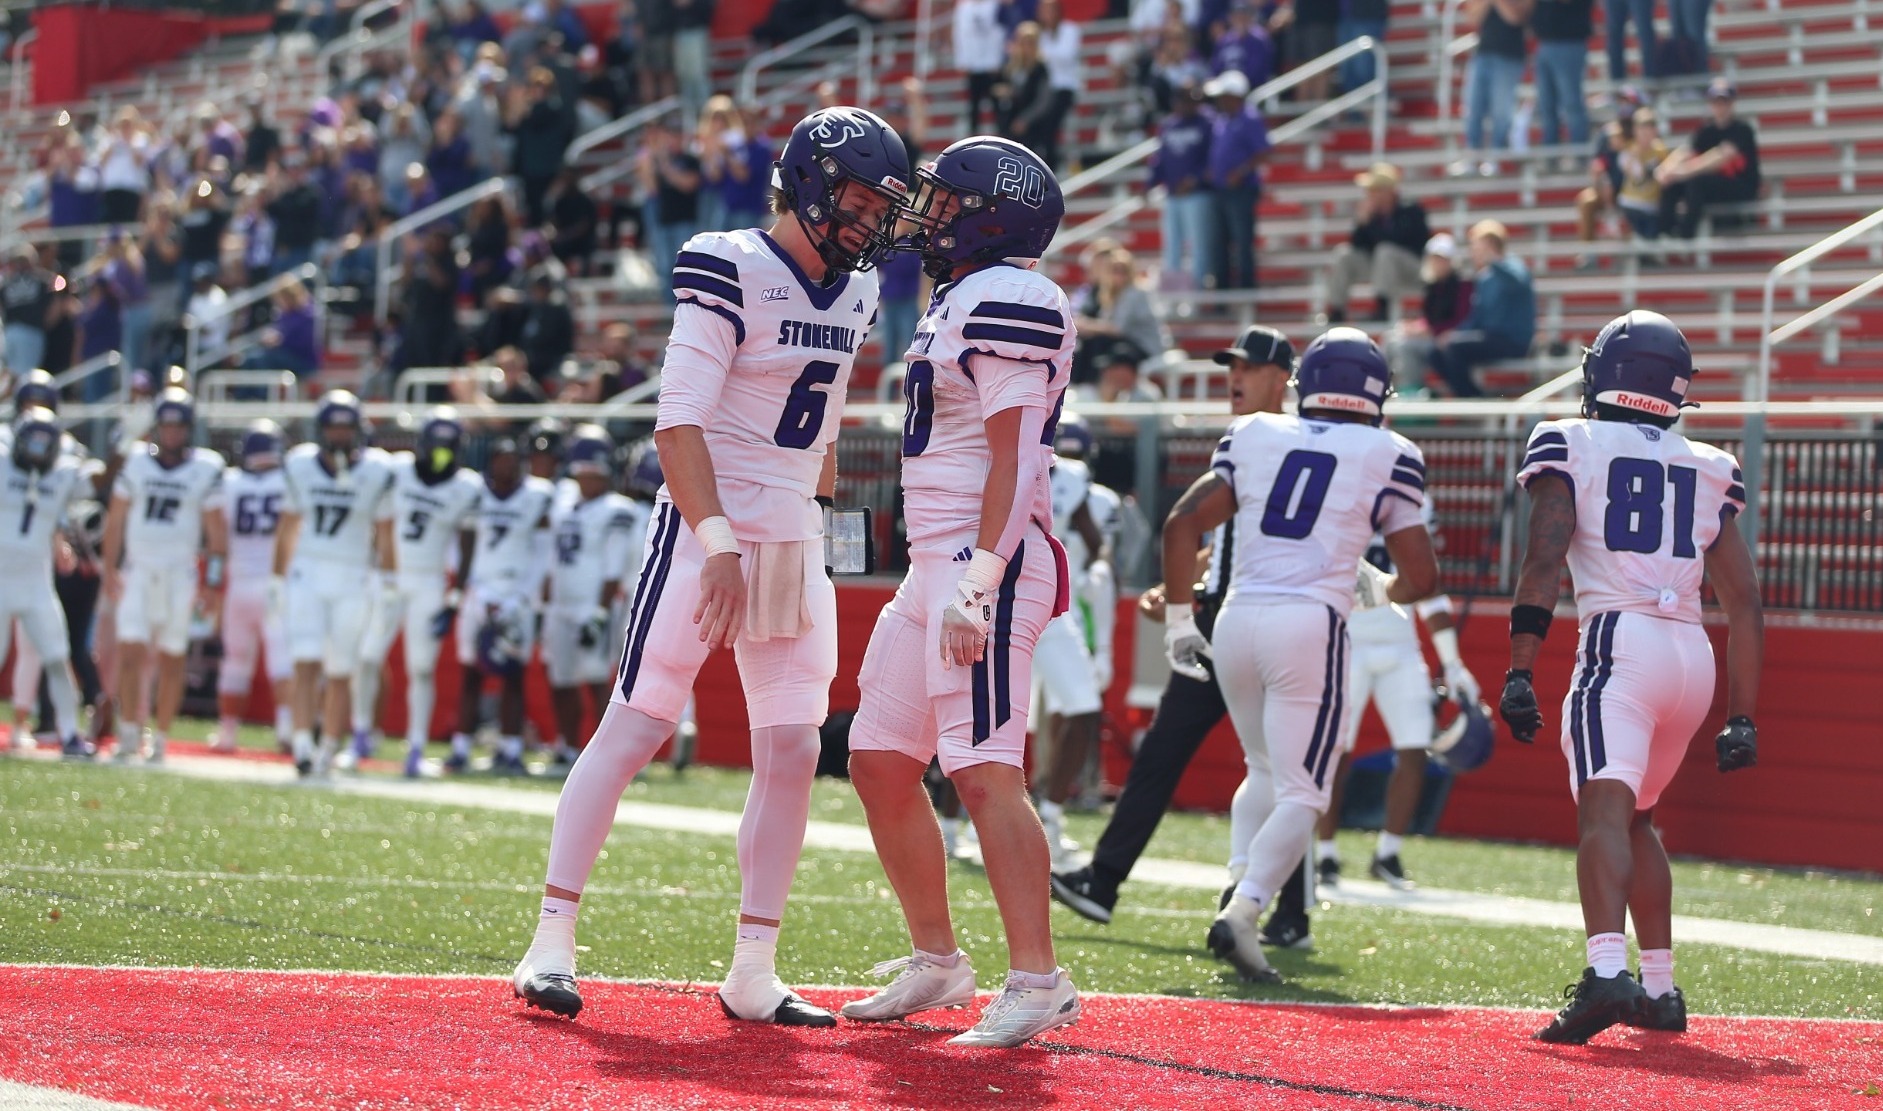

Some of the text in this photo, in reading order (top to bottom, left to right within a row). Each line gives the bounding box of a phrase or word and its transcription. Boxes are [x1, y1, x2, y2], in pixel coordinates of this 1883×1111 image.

[993, 156, 1045, 209] 20
[761, 286, 789, 300] NEC
[778, 320, 856, 354] STONEHILL
[774, 360, 840, 449] 6
[902, 360, 935, 457] 0
[1318, 395, 1366, 410] Riddell
[1615, 393, 1669, 415] Riddell
[1260, 449, 1338, 540] 0
[1603, 457, 1698, 558] 81
[314, 505, 351, 536] 17
[404, 511, 429, 541] 5
